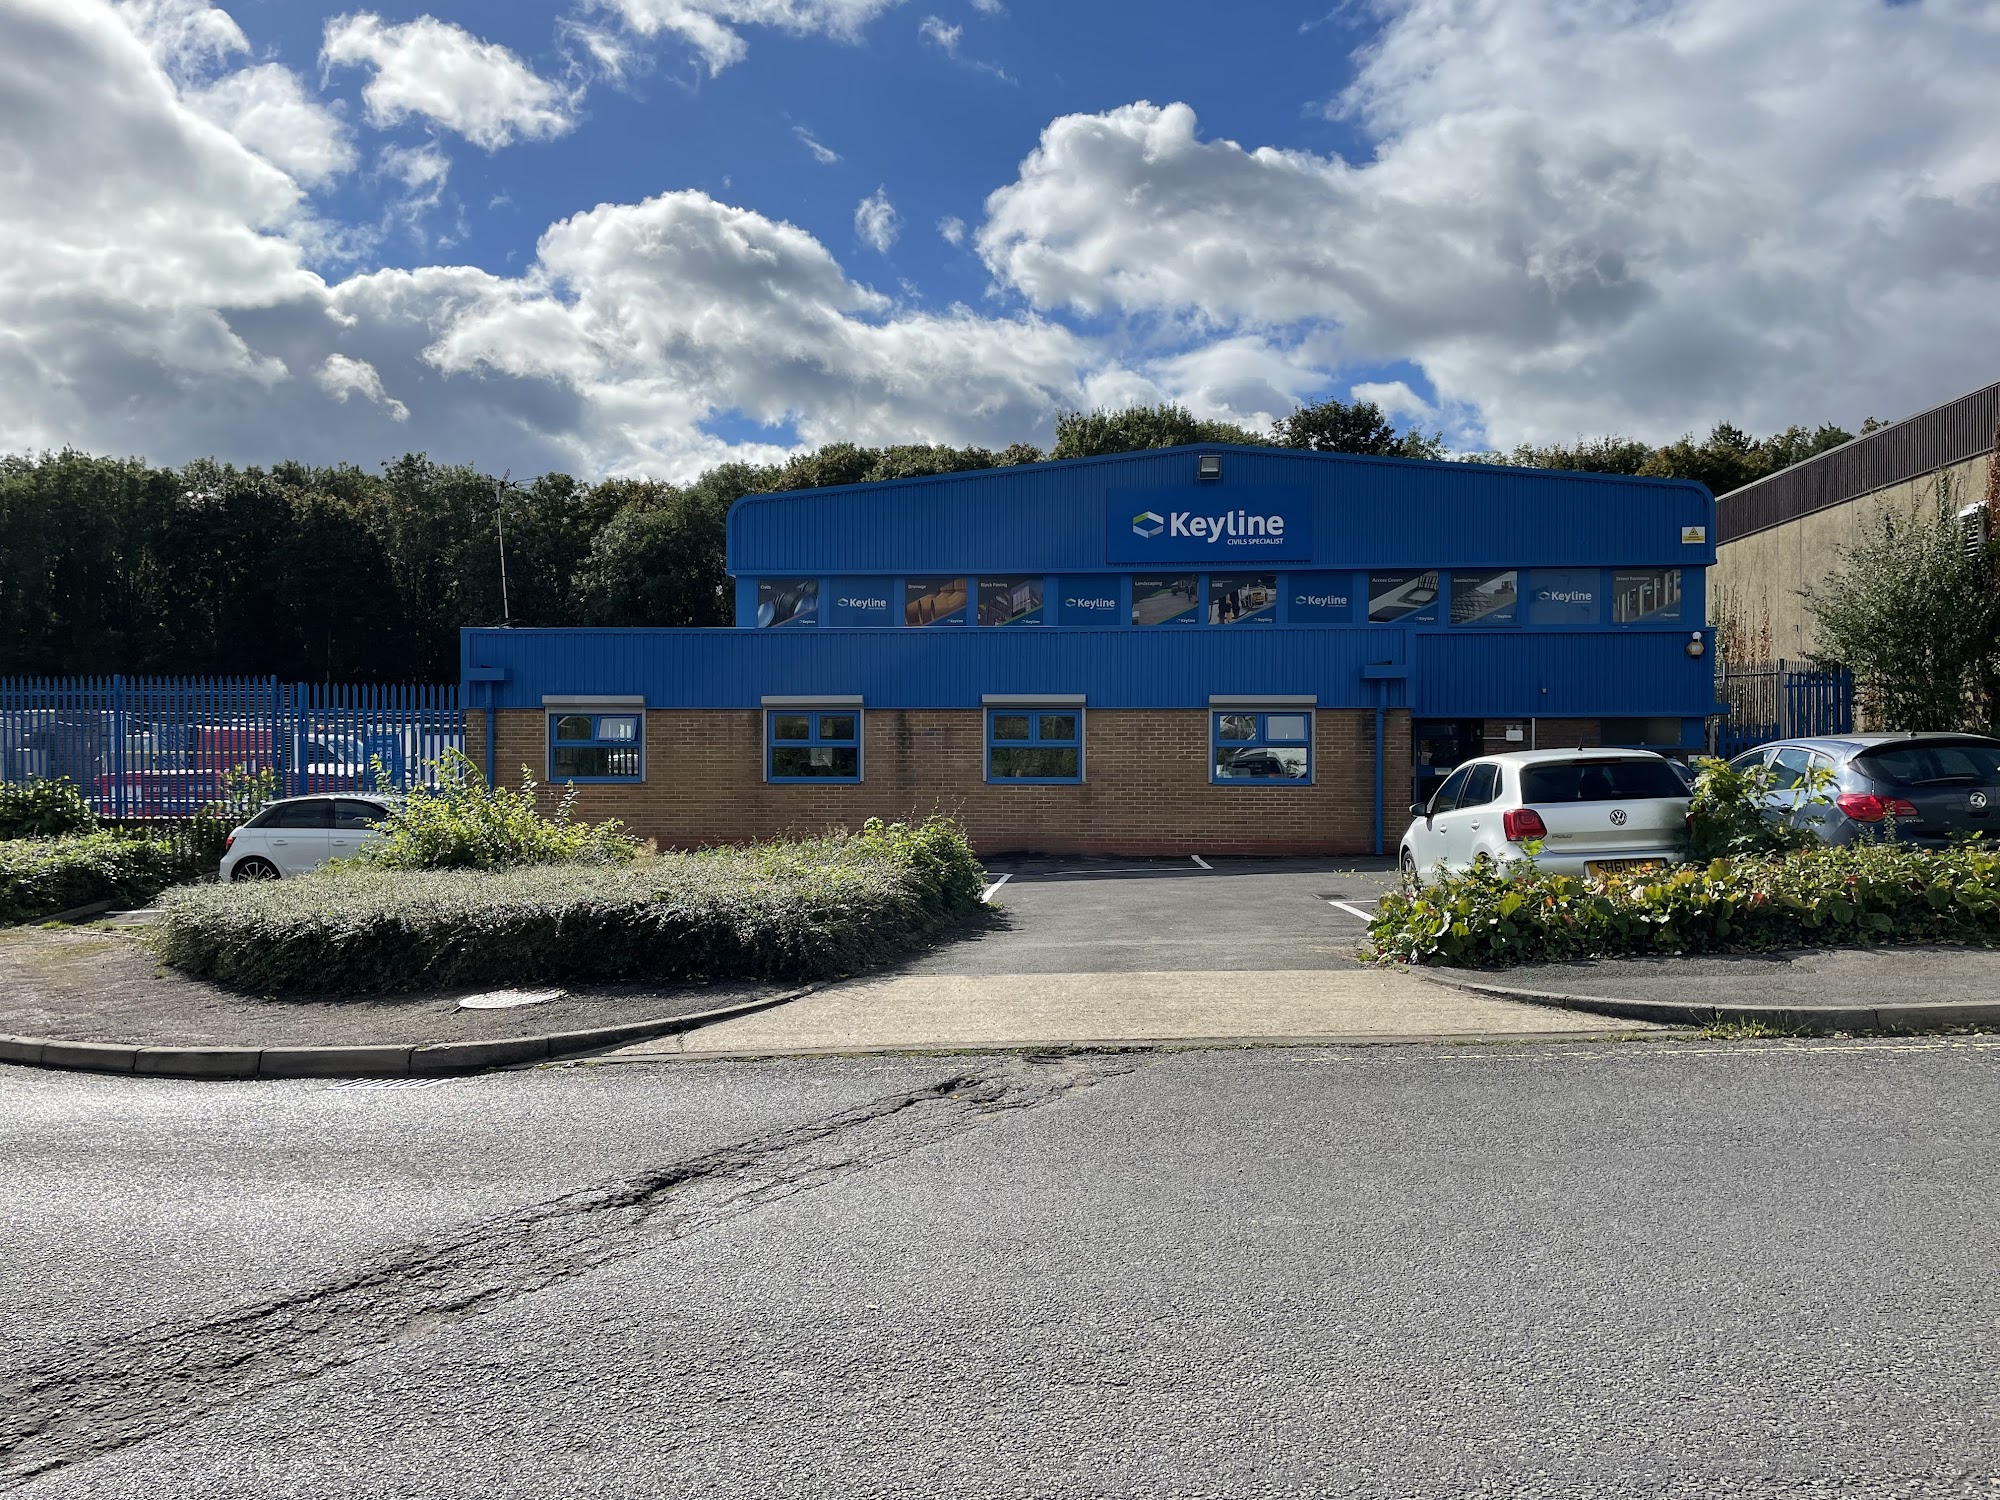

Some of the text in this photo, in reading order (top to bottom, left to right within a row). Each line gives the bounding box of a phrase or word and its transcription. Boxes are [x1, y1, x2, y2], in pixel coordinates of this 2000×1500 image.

[1170, 510, 1285, 543] Keyline
[1248, 537, 1284, 545] SPECIALIST
[1308, 595, 1347, 607] Keyline
[1551, 591, 1592, 603] Keyline
[849, 598, 887, 609] Keyline
[1077, 598, 1115, 609] Keyline
[1596, 860, 1626, 873] SH61
